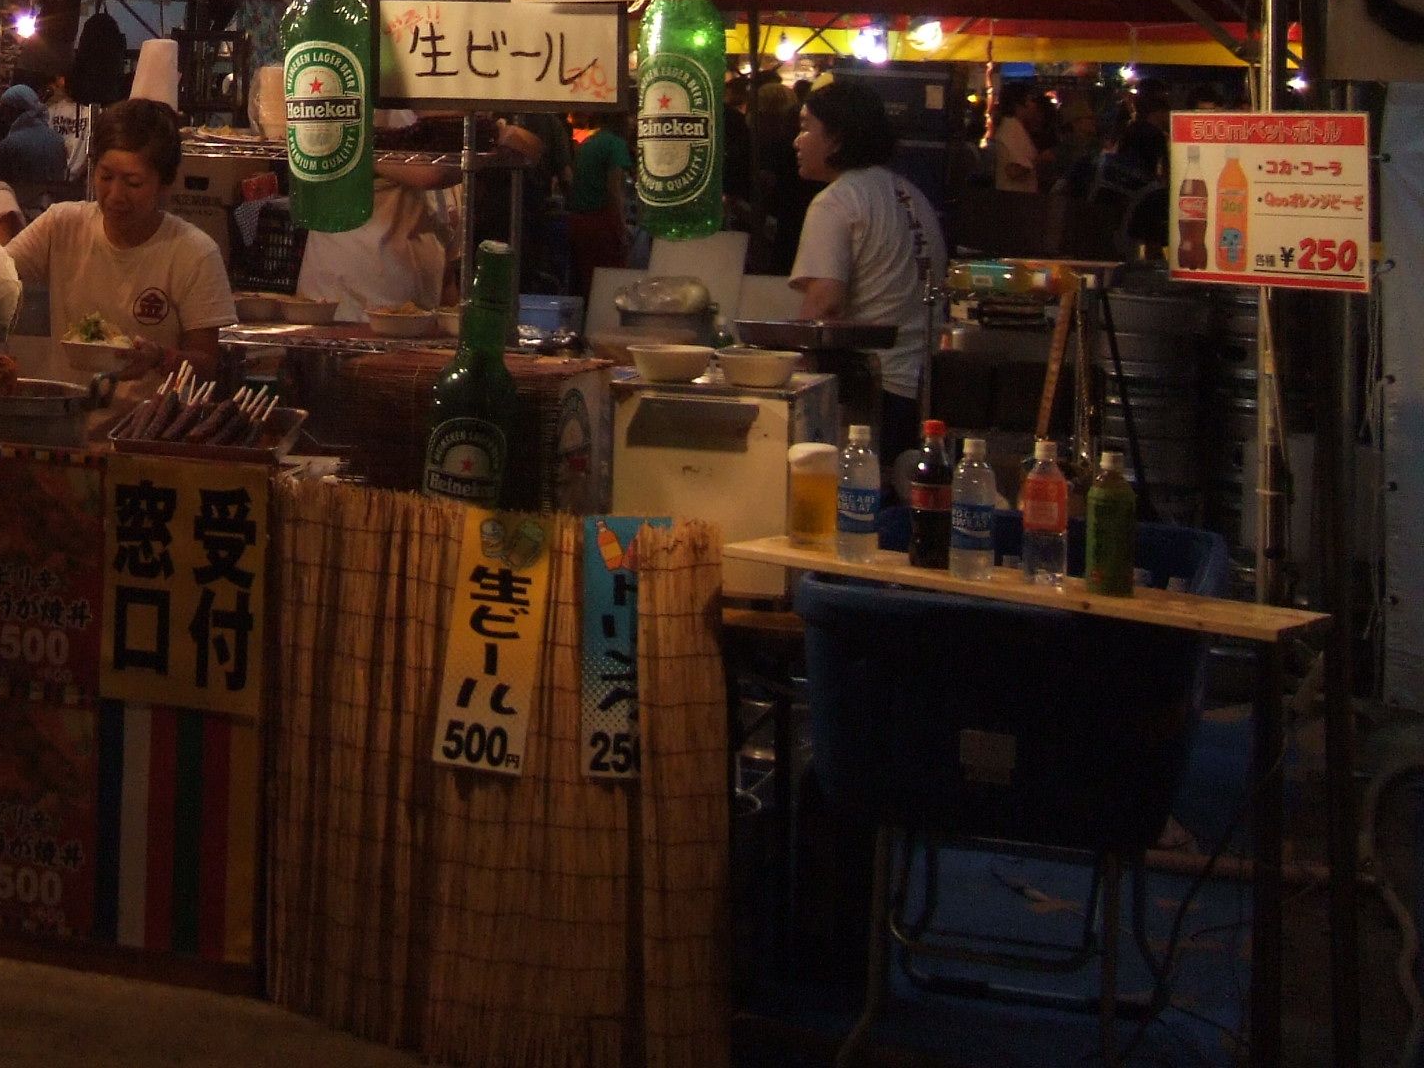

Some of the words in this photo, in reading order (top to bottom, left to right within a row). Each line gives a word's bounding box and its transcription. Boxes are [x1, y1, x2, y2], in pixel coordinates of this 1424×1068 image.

[313, 51, 342, 68] LAGER
[409, 22, 598, 85] 生ビール
[287, 101, 356, 119] Heineken
[1280, 238, 1359, 272] ¥250
[112, 480, 177, 676] 窓口
[188, 487, 257, 692] 受付
[456, 564, 532, 716] 生ビール
[442, 719, 521, 770] 500円
[589, 732, 640, 774] 25
